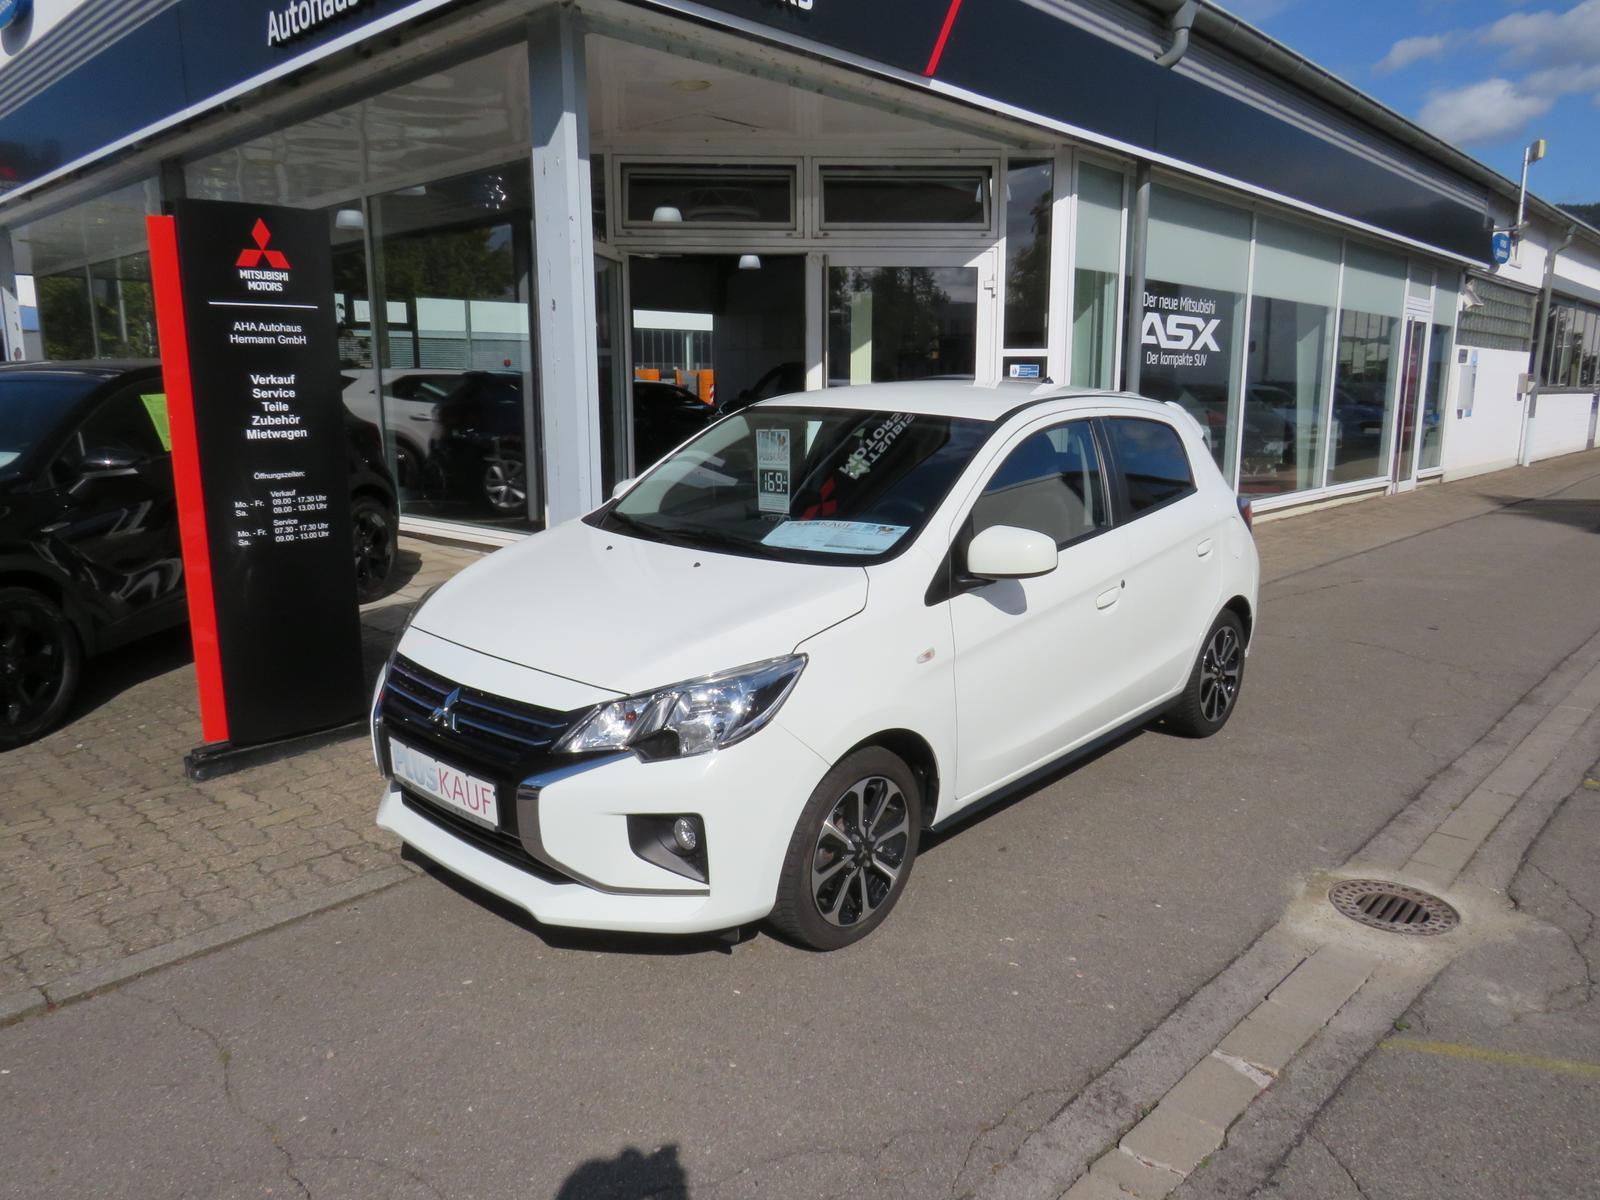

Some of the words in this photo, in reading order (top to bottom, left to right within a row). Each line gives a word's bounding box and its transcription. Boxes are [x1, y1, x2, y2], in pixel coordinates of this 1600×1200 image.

[239, 269, 289, 281] MITSUBISHI
[247, 281, 283, 291] MOTORS
[1143, 292, 1157, 308] Der
[1159, 296, 1178, 311] neue
[1180, 297, 1216, 315] Mitsubishi
[233, 322, 257, 332] AHA
[258, 322, 302, 333] Autohaus
[1141, 312, 1221, 352] ASX
[230, 334, 276, 344] Hermann
[278, 335, 307, 345] GmbH
[1146, 352, 1159, 365] Der
[1160, 352, 1193, 368] kompakte
[1194, 354, 1208, 366] SUV
[250, 374, 296, 385] Verkauf
[252, 388, 296, 398] Service
[262, 401, 289, 412] Teile
[252, 414, 301, 426] Zubehör
[246, 429, 308, 440] Mietwagen
[270, 489, 296, 497] Verkauf
[273, 498, 292, 506] 09.00
[273, 506, 293, 514] 09.00
[275, 534, 295, 542] 09.00
